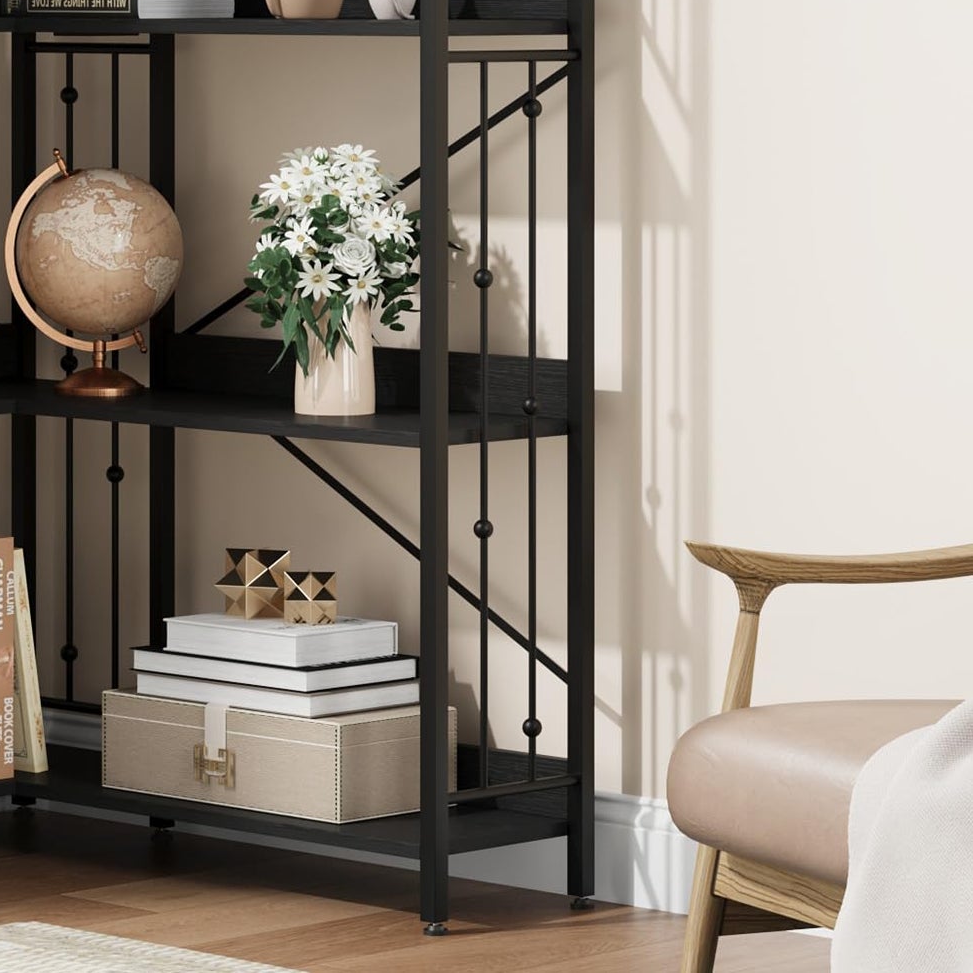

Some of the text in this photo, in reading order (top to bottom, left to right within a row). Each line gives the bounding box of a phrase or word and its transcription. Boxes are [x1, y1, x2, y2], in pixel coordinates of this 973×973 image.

[6, 570, 14, 615] CALLUM
[4, 697, 14, 765] BOOK COVER
